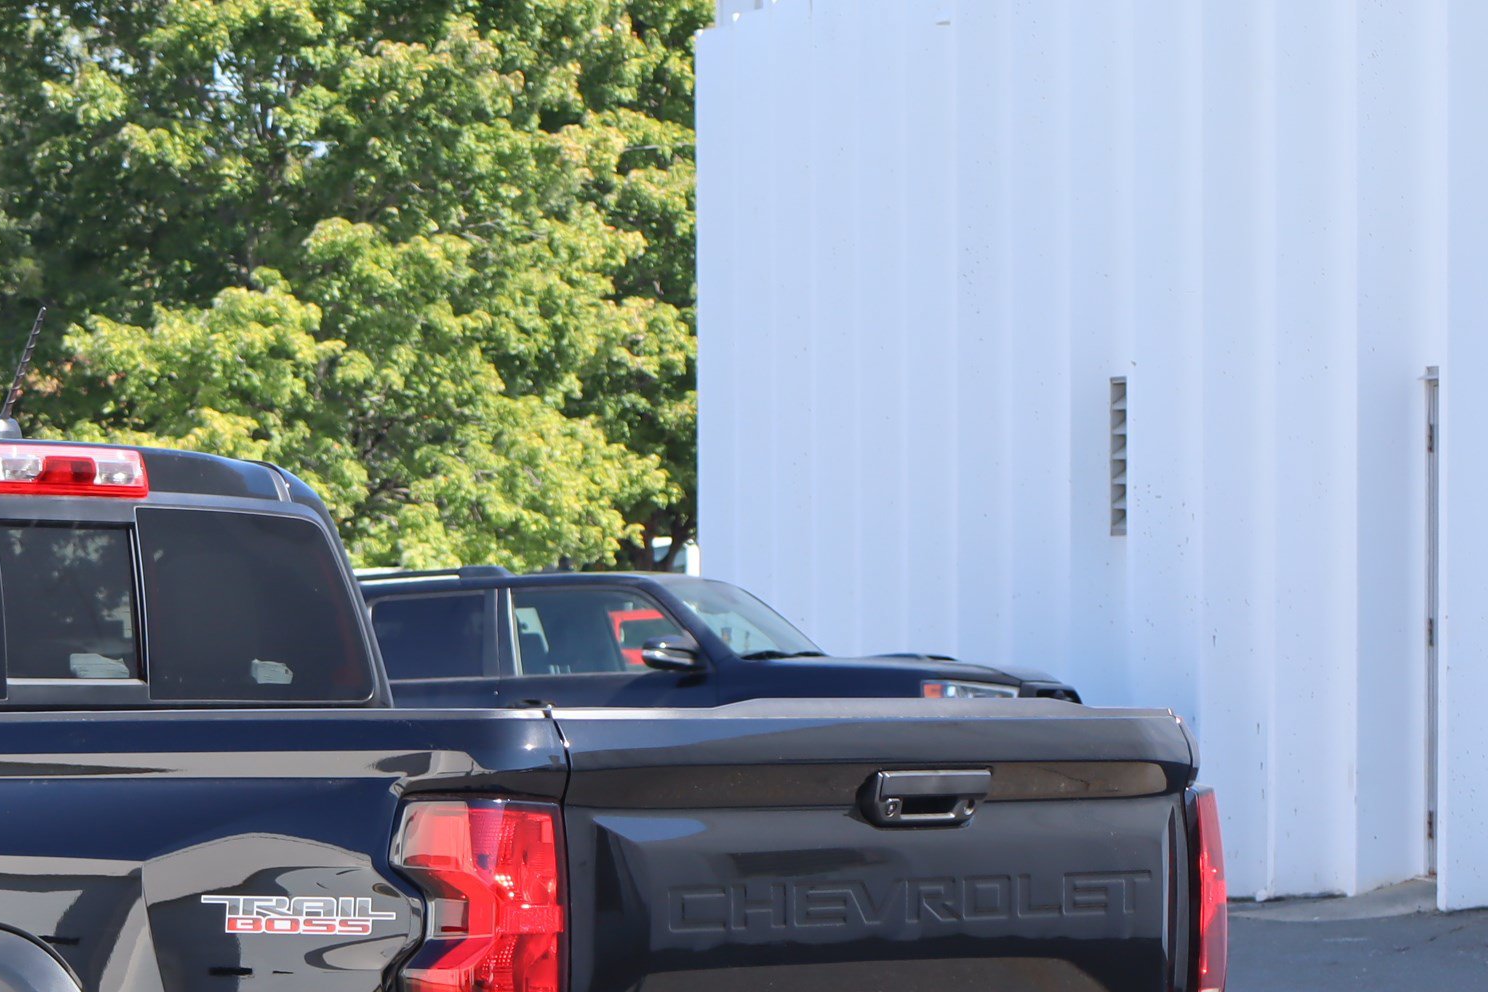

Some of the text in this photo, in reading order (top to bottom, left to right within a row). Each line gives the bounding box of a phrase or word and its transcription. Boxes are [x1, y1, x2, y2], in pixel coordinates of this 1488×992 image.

[201, 895, 396, 919] TRAIL
[668, 869, 1152, 932] CHEVROLET
[225, 917, 371, 935] BOSS
